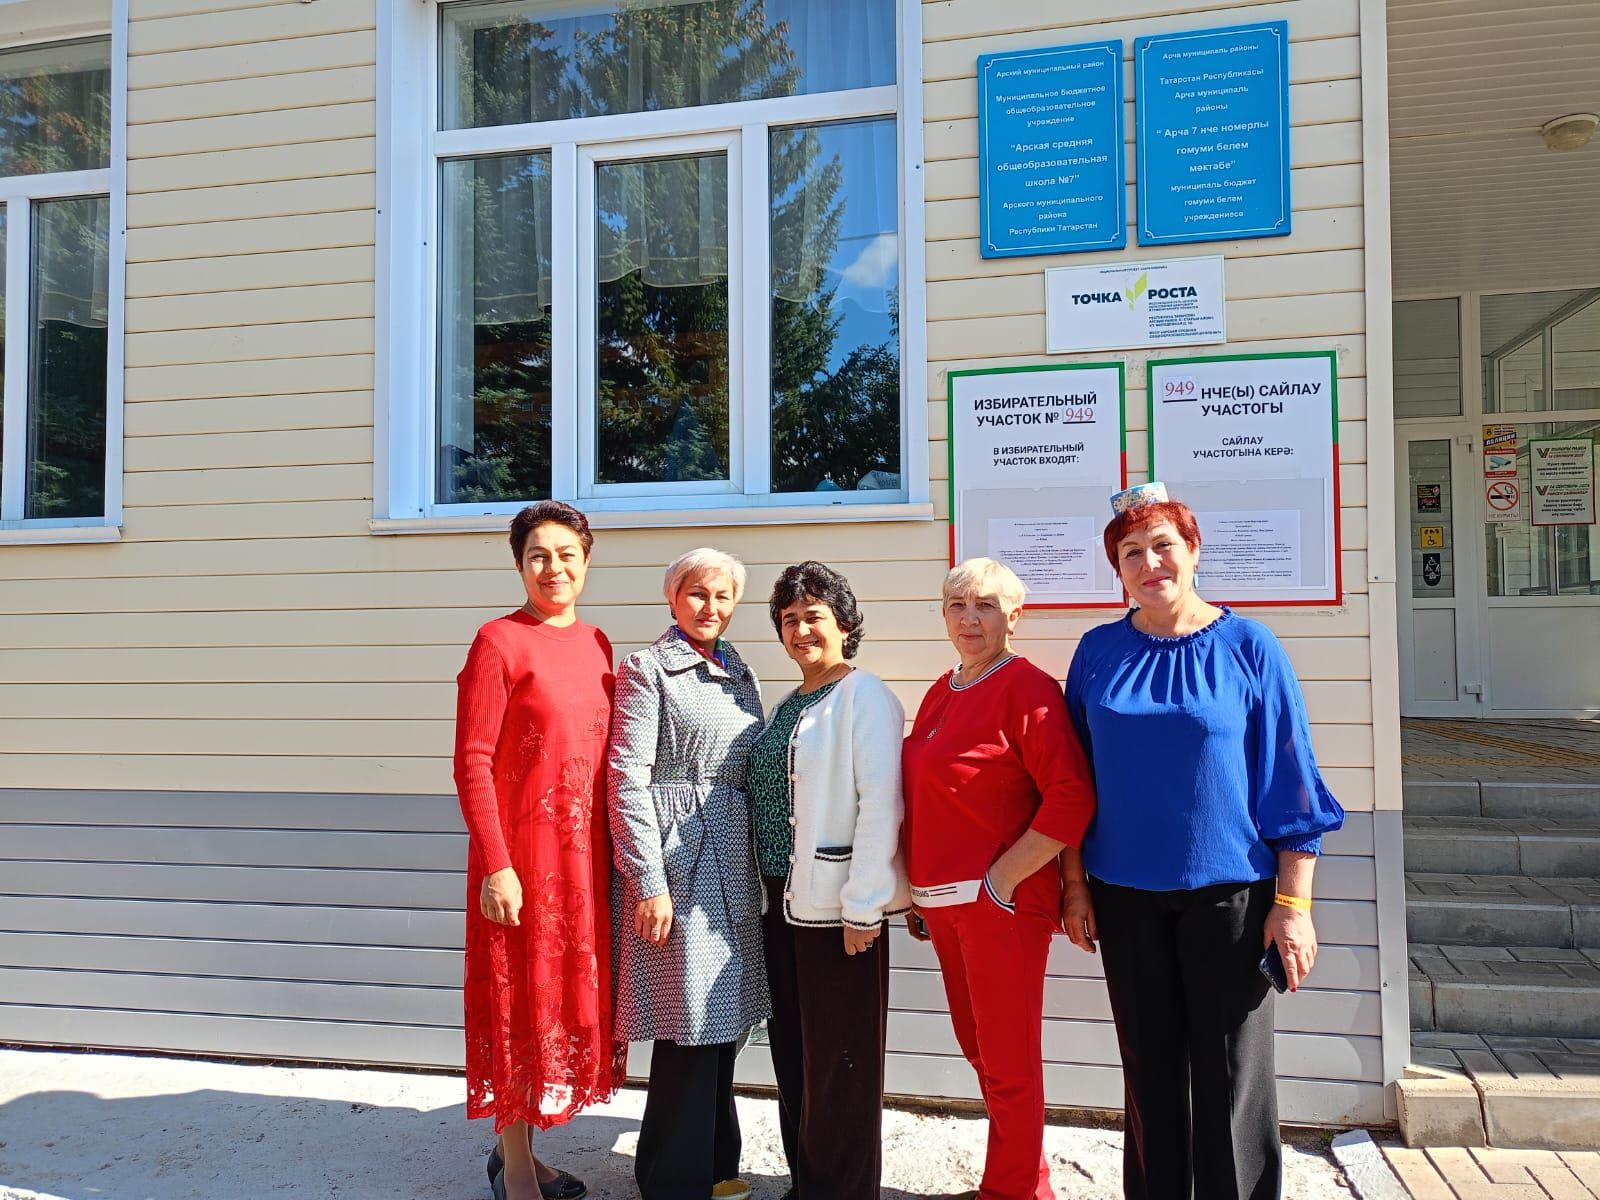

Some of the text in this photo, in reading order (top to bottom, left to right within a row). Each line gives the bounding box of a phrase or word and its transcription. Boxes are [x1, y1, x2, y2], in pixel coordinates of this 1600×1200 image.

[1182, 48, 1228, 58] муниципаль
[1230, 44, 1259, 54] районы
[996, 61, 1105, 78] Арский муниципальный район
[1159, 68, 1264, 86] Татарстан Республикасы
[995, 85, 1106, 103] Муниципальное бюджетное
[1174, 86, 1249, 100] Арча муниципаль
[1005, 100, 1096, 115] общеобразовательное
[1195, 103, 1228, 114] районы
[1026, 116, 1075, 127] учреждение
[1164, 128, 1189, 139] Арча
[1191, 126, 1198, 135] 7
[1200, 126, 1219, 134] нче
[1221, 120, 1269, 132] номерлы
[1052, 138, 1093, 150] средняя
[1176, 142, 1249, 155] гомуми белем
[997, 155, 1108, 171] общеобразовательная
[1025, 177, 1056, 187] школа
[1170, 178, 1257, 193] муниципаль бюджет
[1002, 195, 1104, 210] Арского муниципального
[1184, 197, 1215, 206] гомуми
[1038, 211, 1067, 221] района
[1009, 222, 1098, 236] Республики Татарстан
[1071, 286, 1198, 305] ТОЧКА РОСТА
[1165, 380, 1321, 400] 949 НЧЕ(Ы) САЙЛАУ
[974, 391, 1097, 411] ИЗБИРАТЕЛЬНЫЙ
[1201, 402, 1284, 417] УЧАСТОГЫ
[976, 407, 1094, 427] УЧАСТОК № 949
[1222, 435, 1264, 446] САЙЛАУ
[993, 441, 1085, 455] В ИЗБИРАТЕЛЬНЫЙ
[1192, 447, 1294, 459] УЧАСТОГЫНА КЕРӘ:
[993, 455, 1080, 467] УЧАСТОК ВХОДЯТ:
